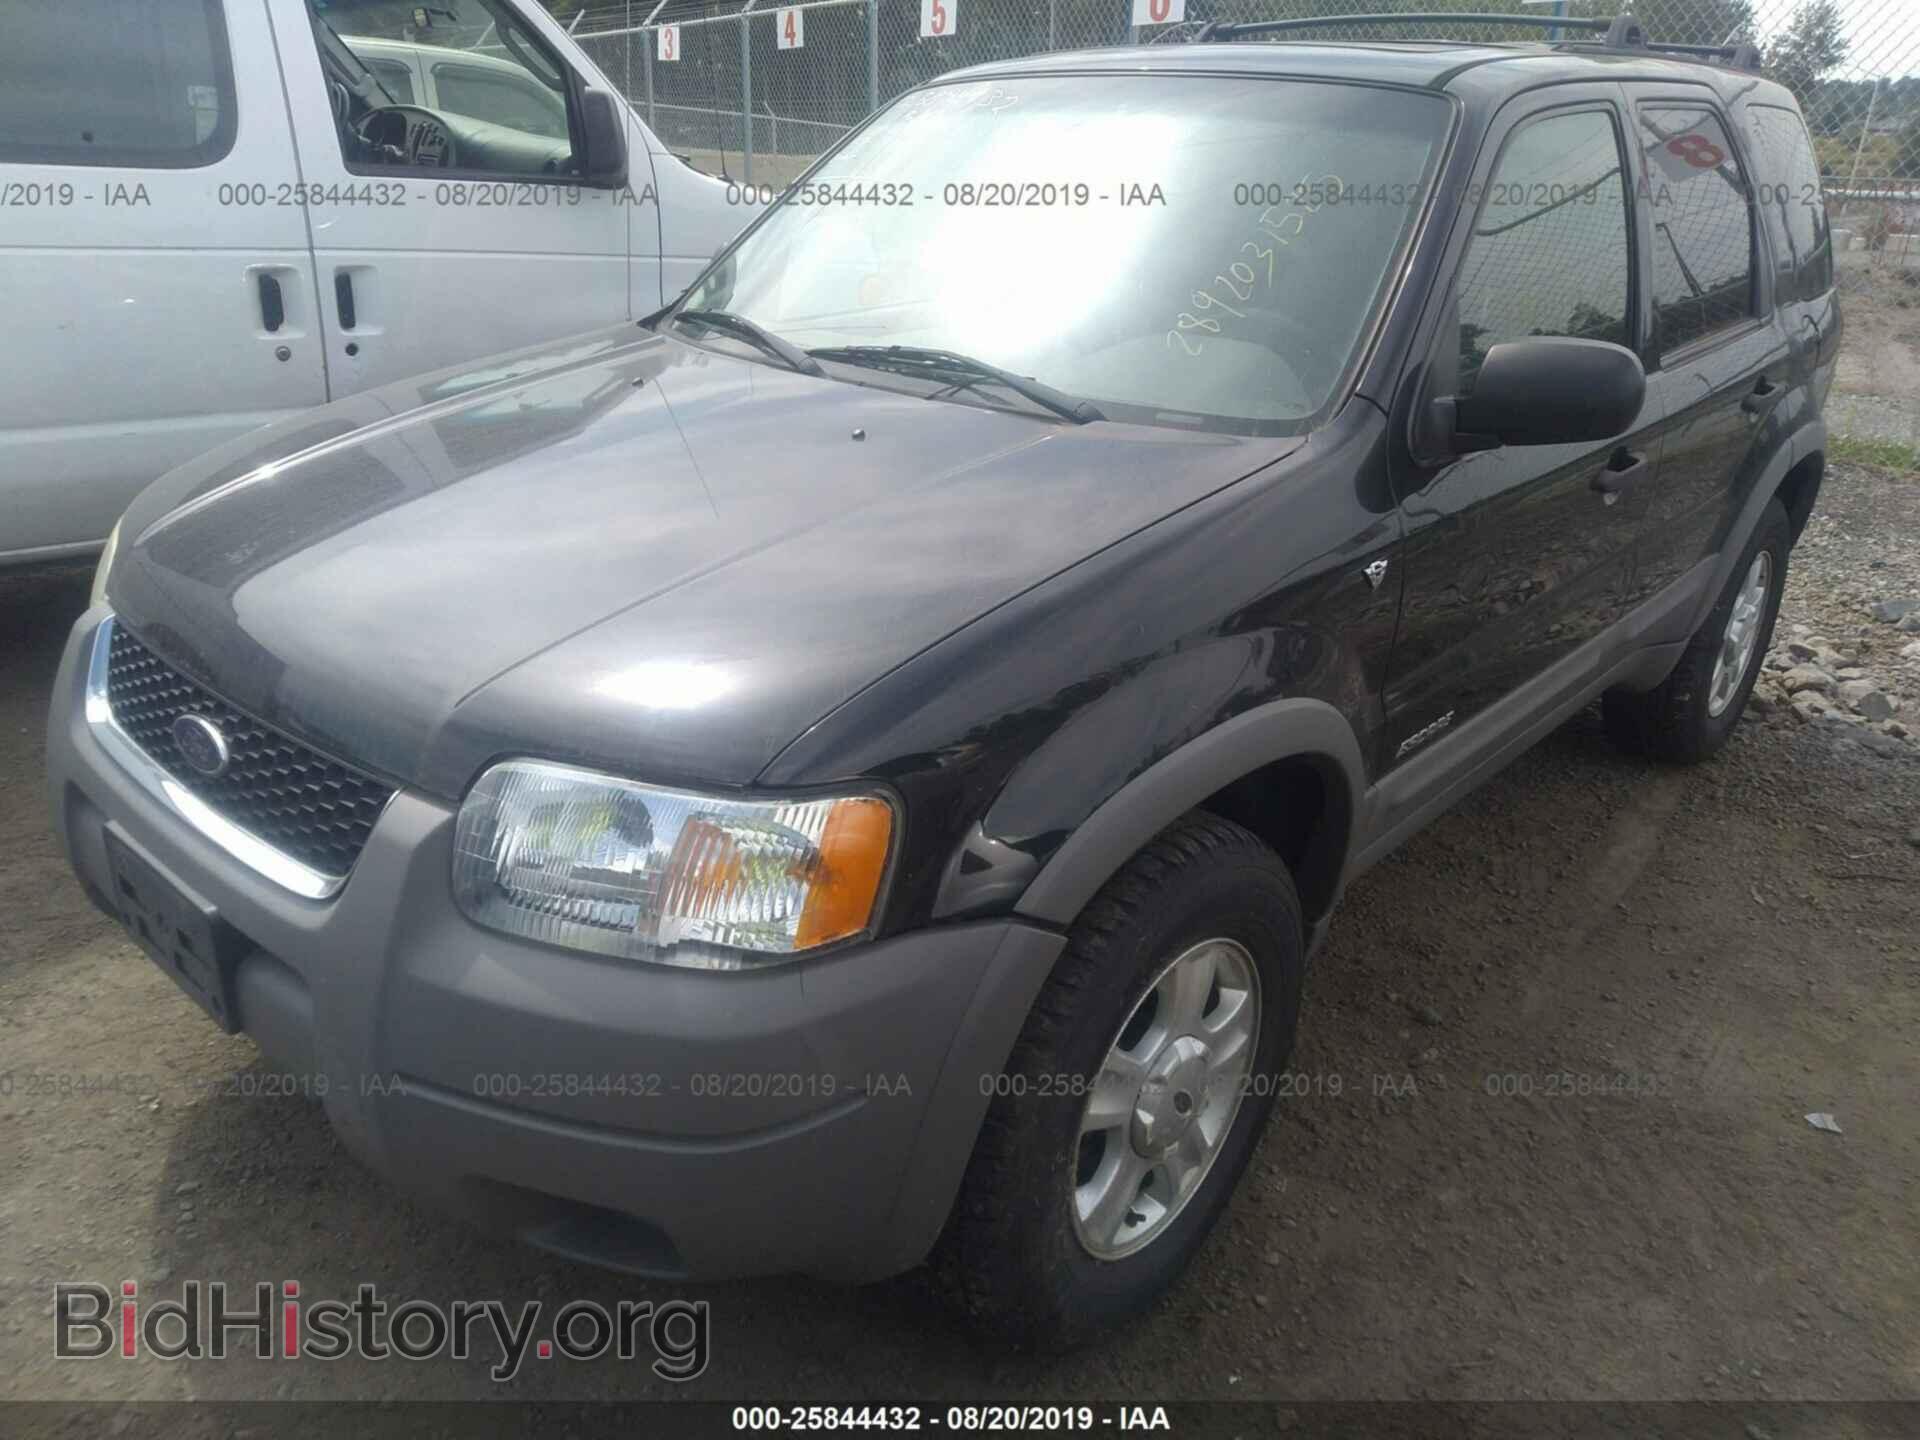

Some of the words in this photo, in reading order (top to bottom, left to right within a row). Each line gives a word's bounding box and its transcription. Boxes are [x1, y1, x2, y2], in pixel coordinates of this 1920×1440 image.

[784, 11, 796, 47] 4
[931, 0, 946, 34] 5
[664, 28, 673, 60] 3
